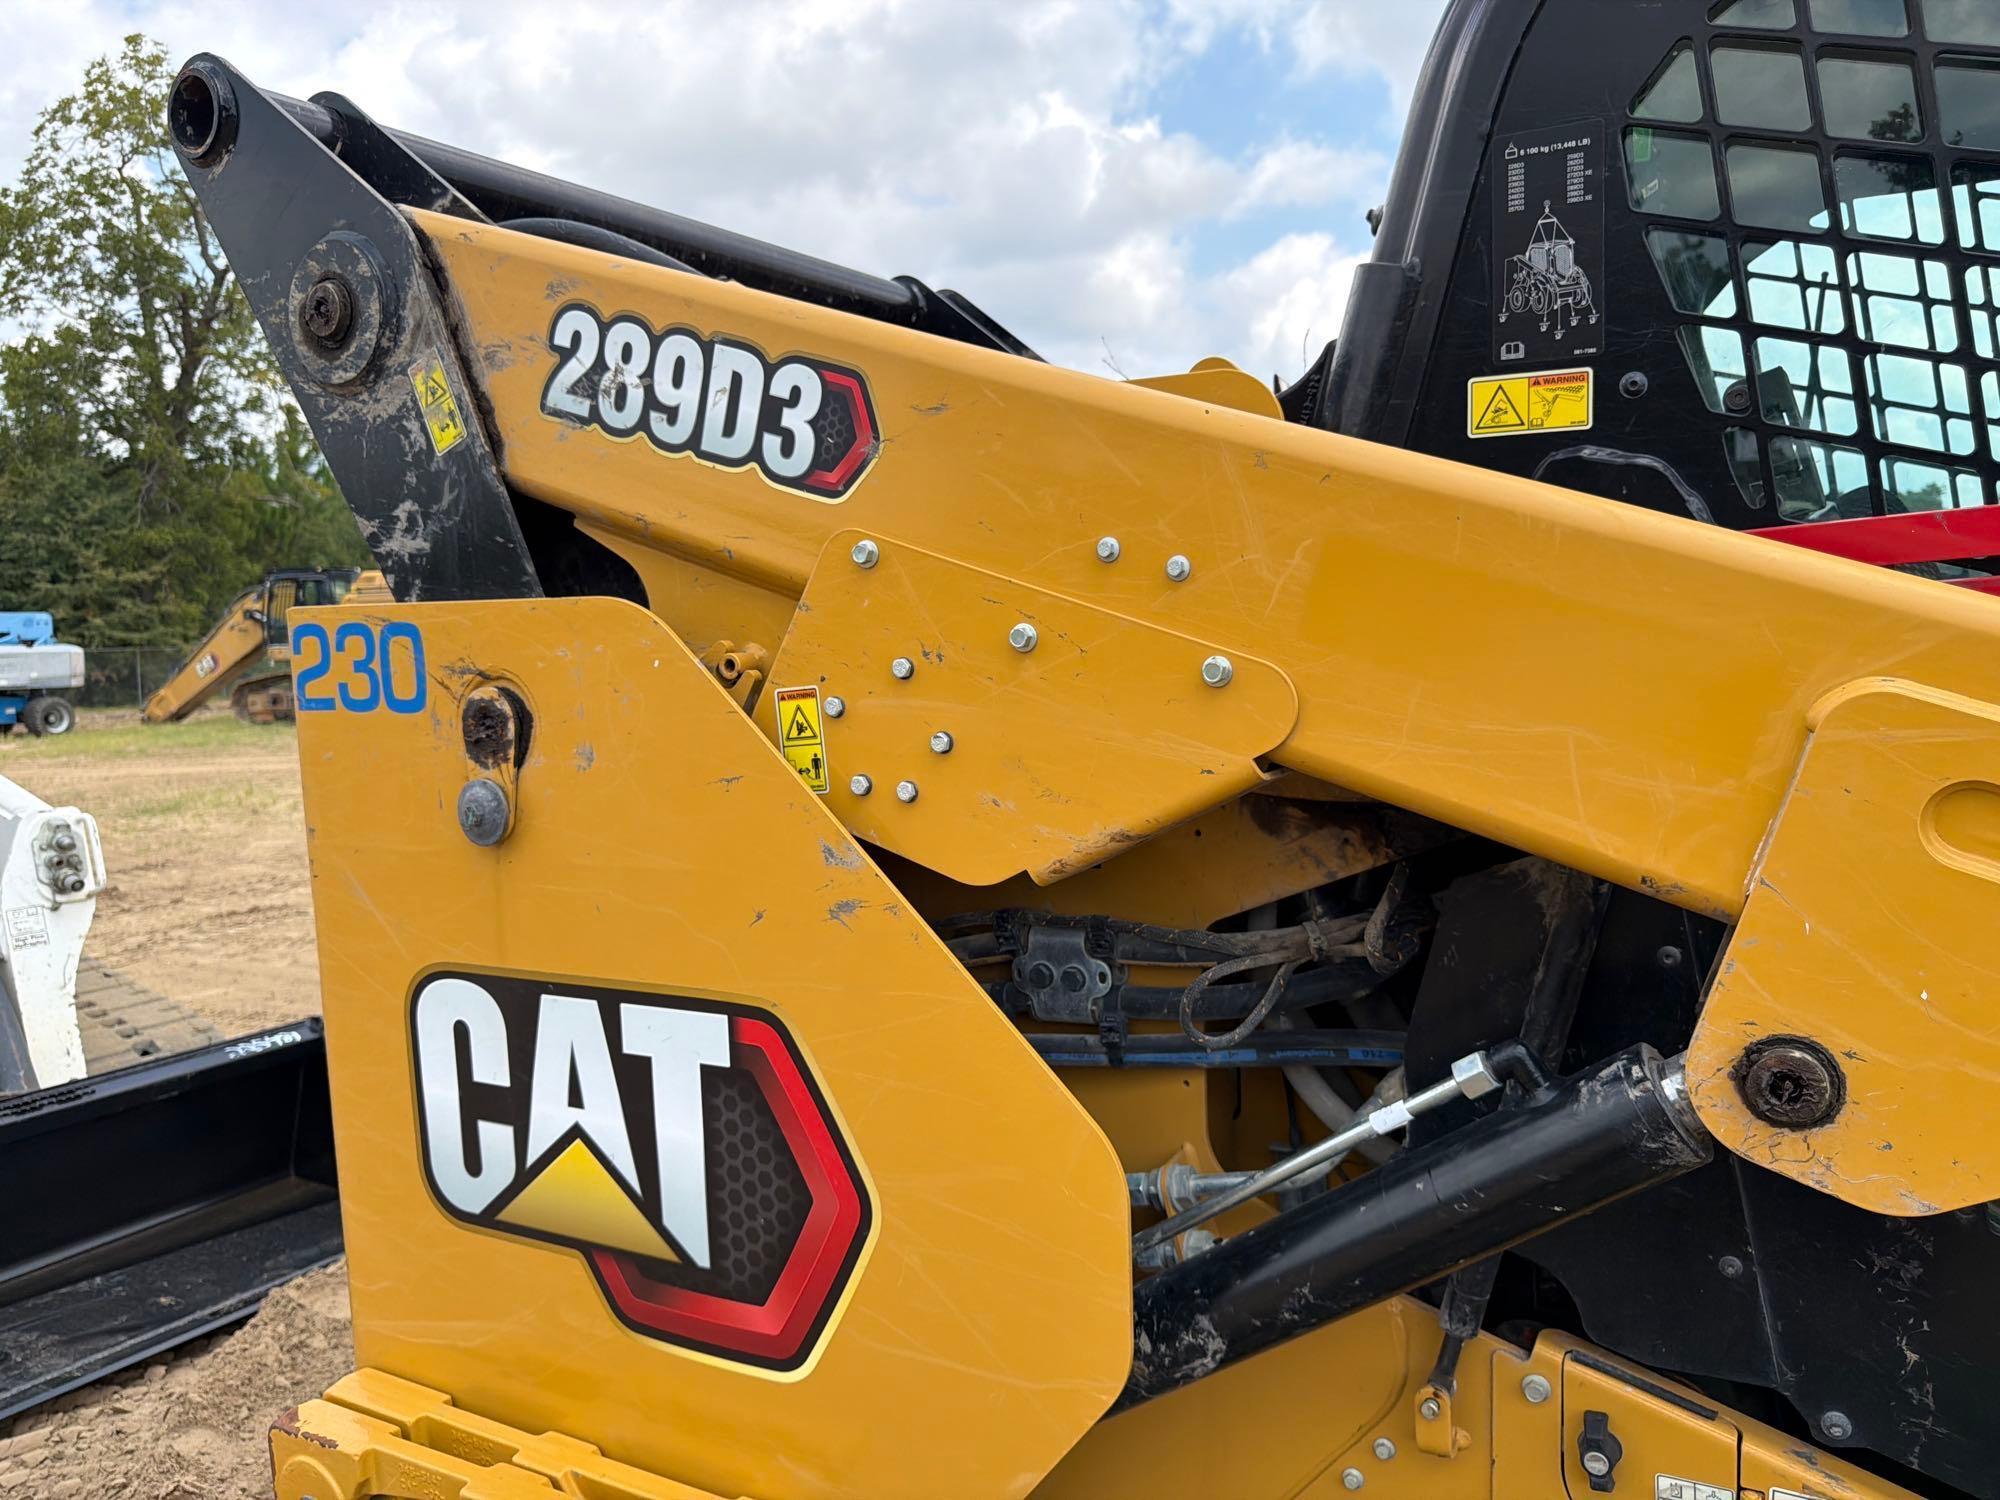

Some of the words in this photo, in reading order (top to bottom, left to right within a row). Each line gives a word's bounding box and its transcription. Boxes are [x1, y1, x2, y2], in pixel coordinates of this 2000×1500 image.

[1526, 147, 1538, 155] 100
[1540, 145, 1549, 153] kg
[1577, 137, 1591, 146] LB)
[546, 310, 822, 478] 289D3
[1542, 374, 1585, 385] WARNING
[292, 621, 427, 714] 230
[786, 691, 816, 701] WARNING
[416, 978, 731, 1270] CAT
